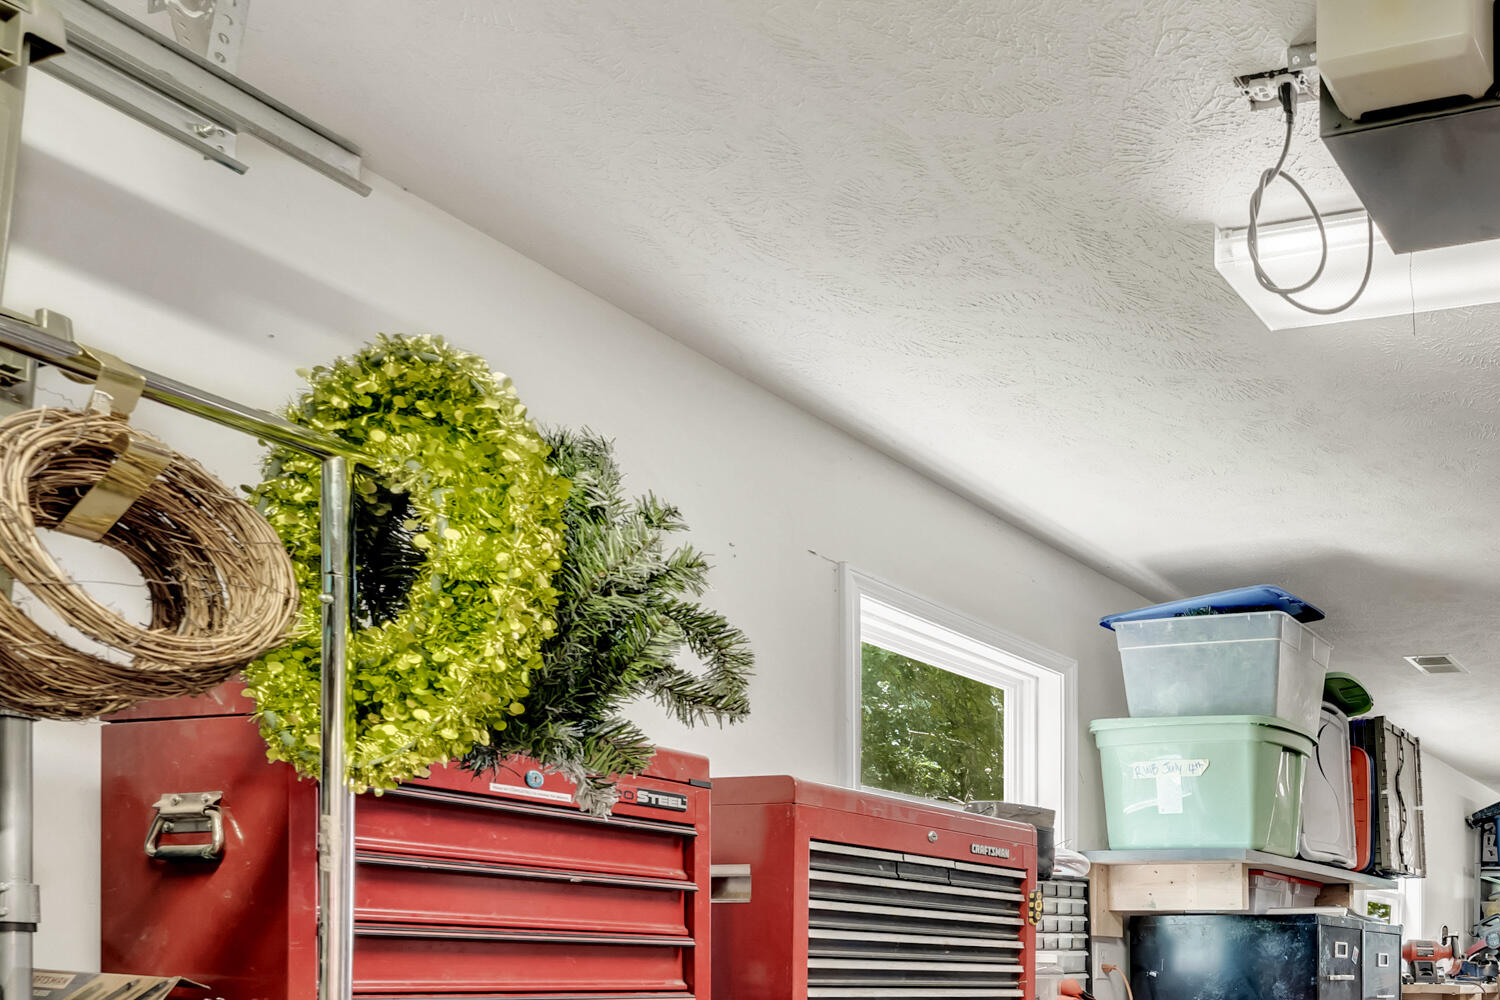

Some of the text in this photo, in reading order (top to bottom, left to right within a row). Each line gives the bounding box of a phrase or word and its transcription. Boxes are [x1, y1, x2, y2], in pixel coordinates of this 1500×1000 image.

[1162, 761, 1183, 775] July
[617, 788, 688, 810] OSTEEL
[971, 843, 1010, 859] CRAFTSMAN
